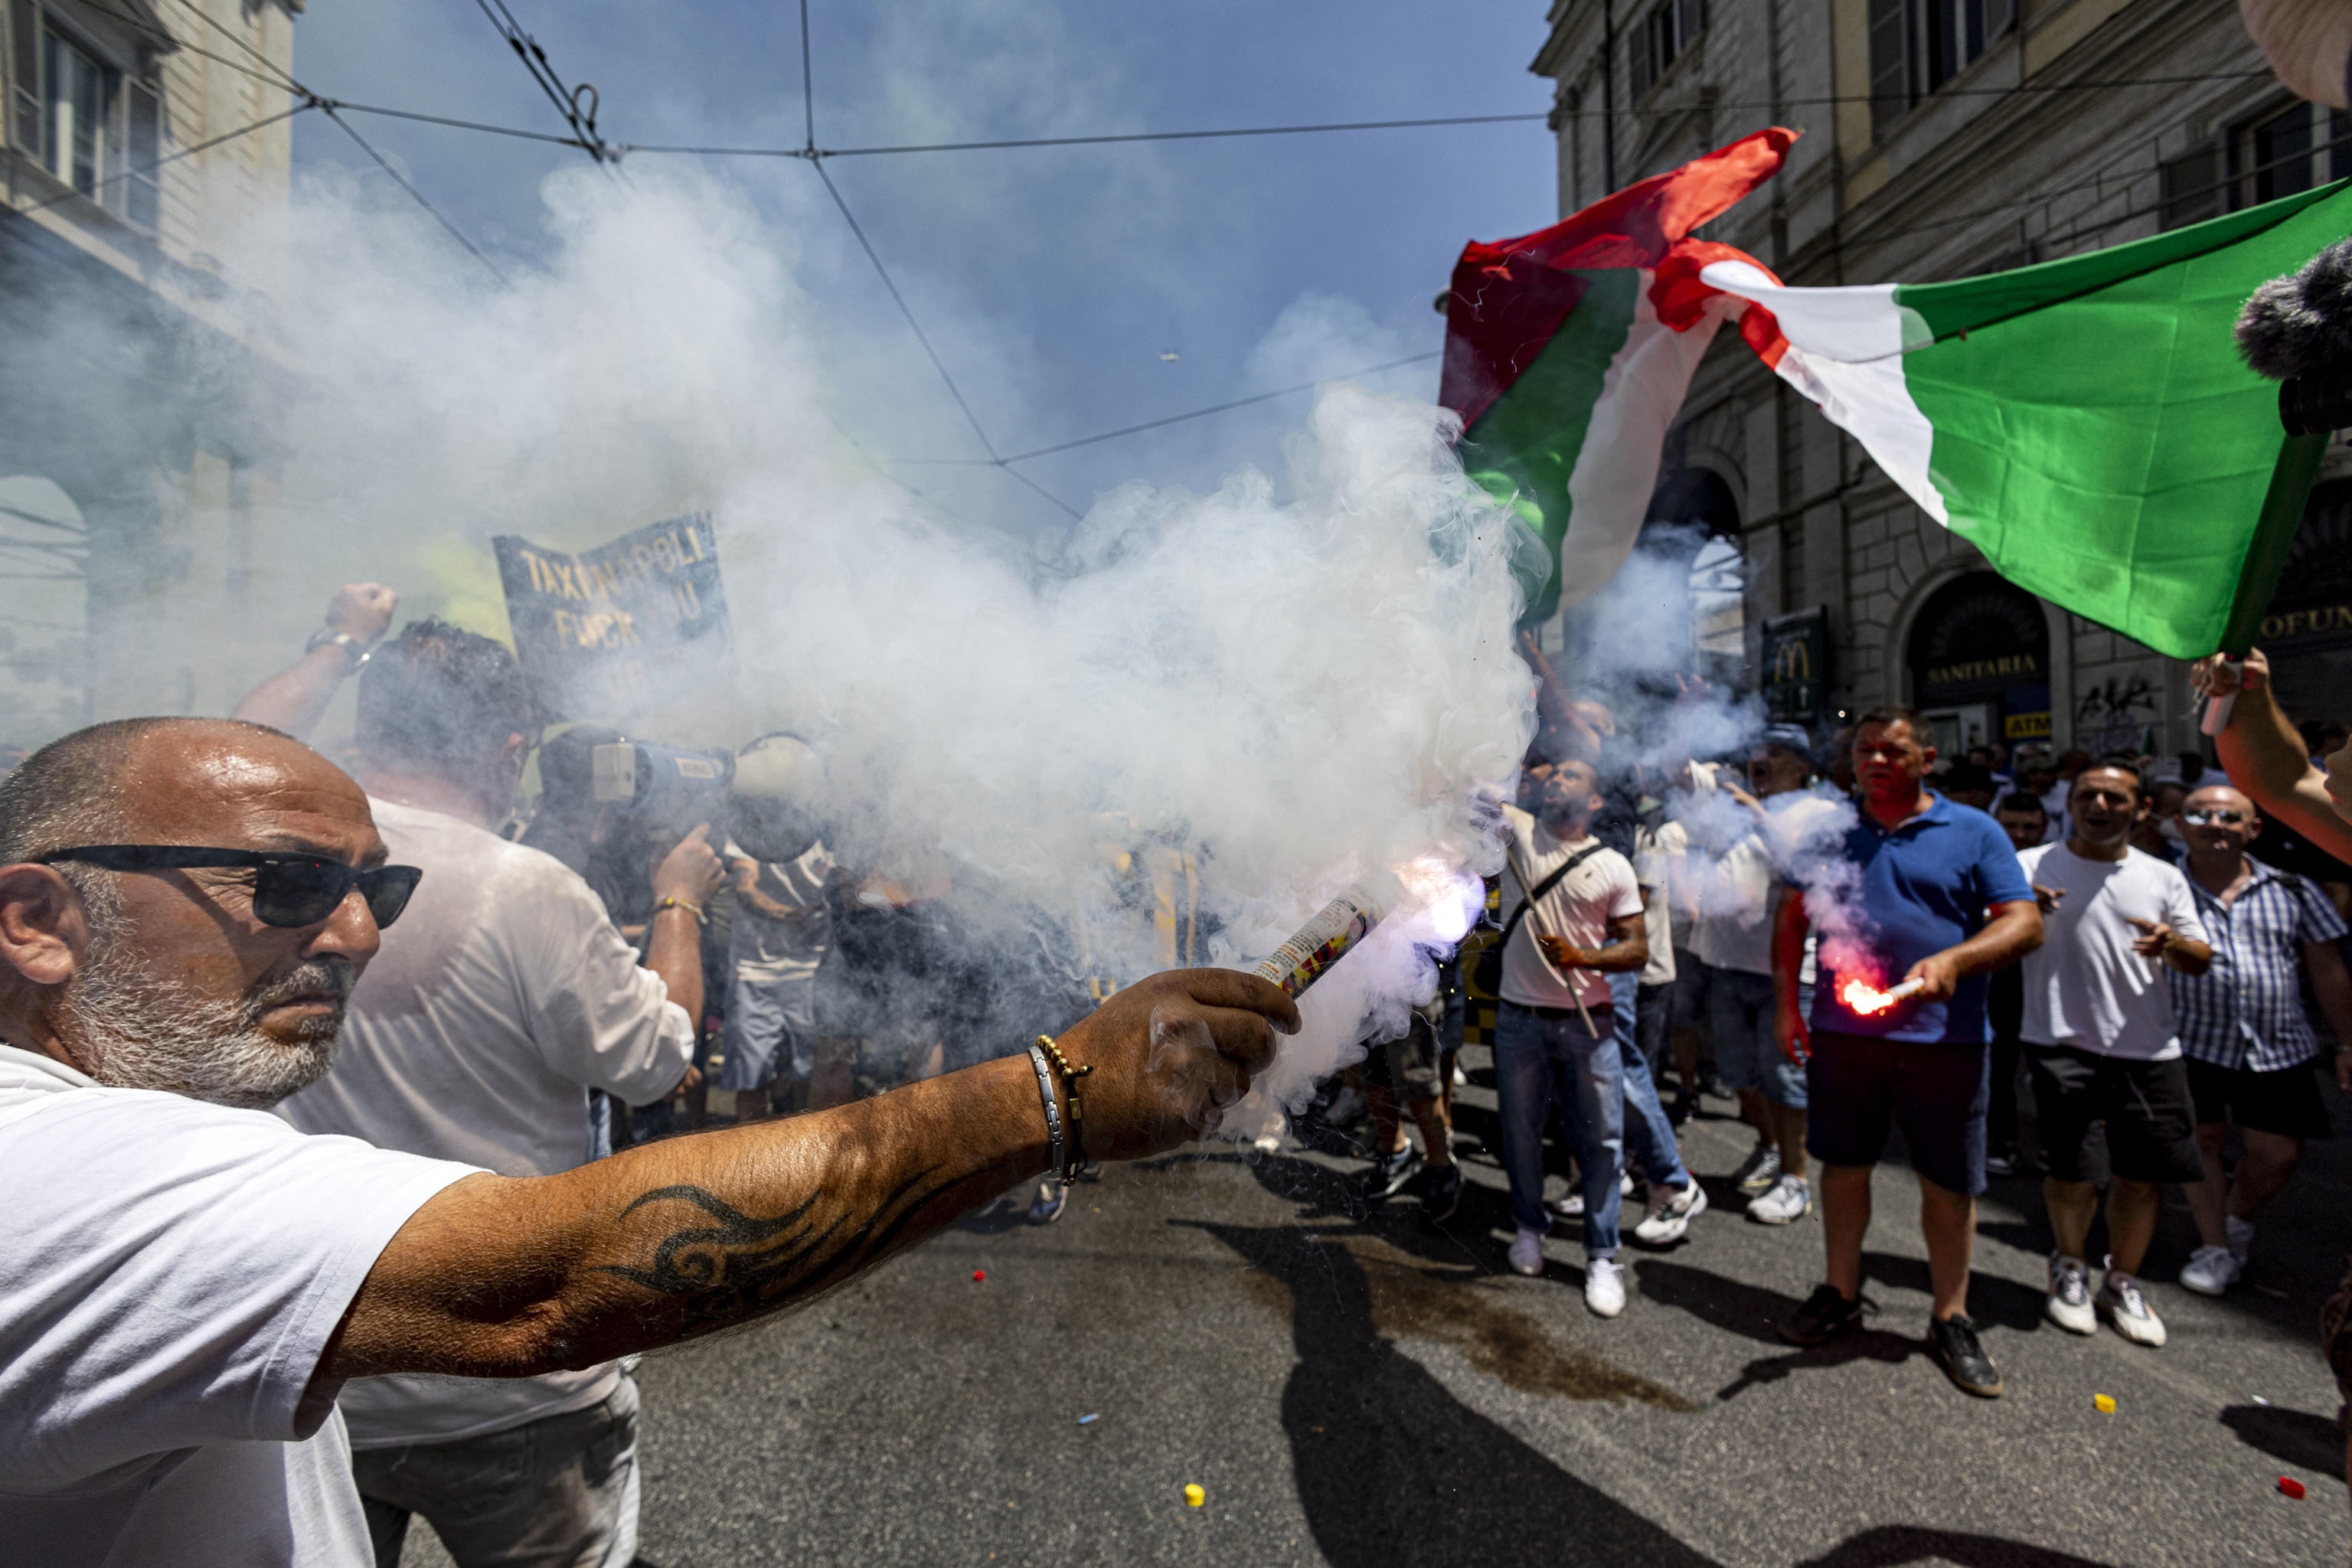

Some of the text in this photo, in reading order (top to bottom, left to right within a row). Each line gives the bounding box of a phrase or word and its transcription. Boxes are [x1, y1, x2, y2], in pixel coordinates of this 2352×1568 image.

[521, 550, 592, 601] TAXI
[1927, 653, 2037, 687] SANITARIA
[2011, 716, 2052, 732] ATM
